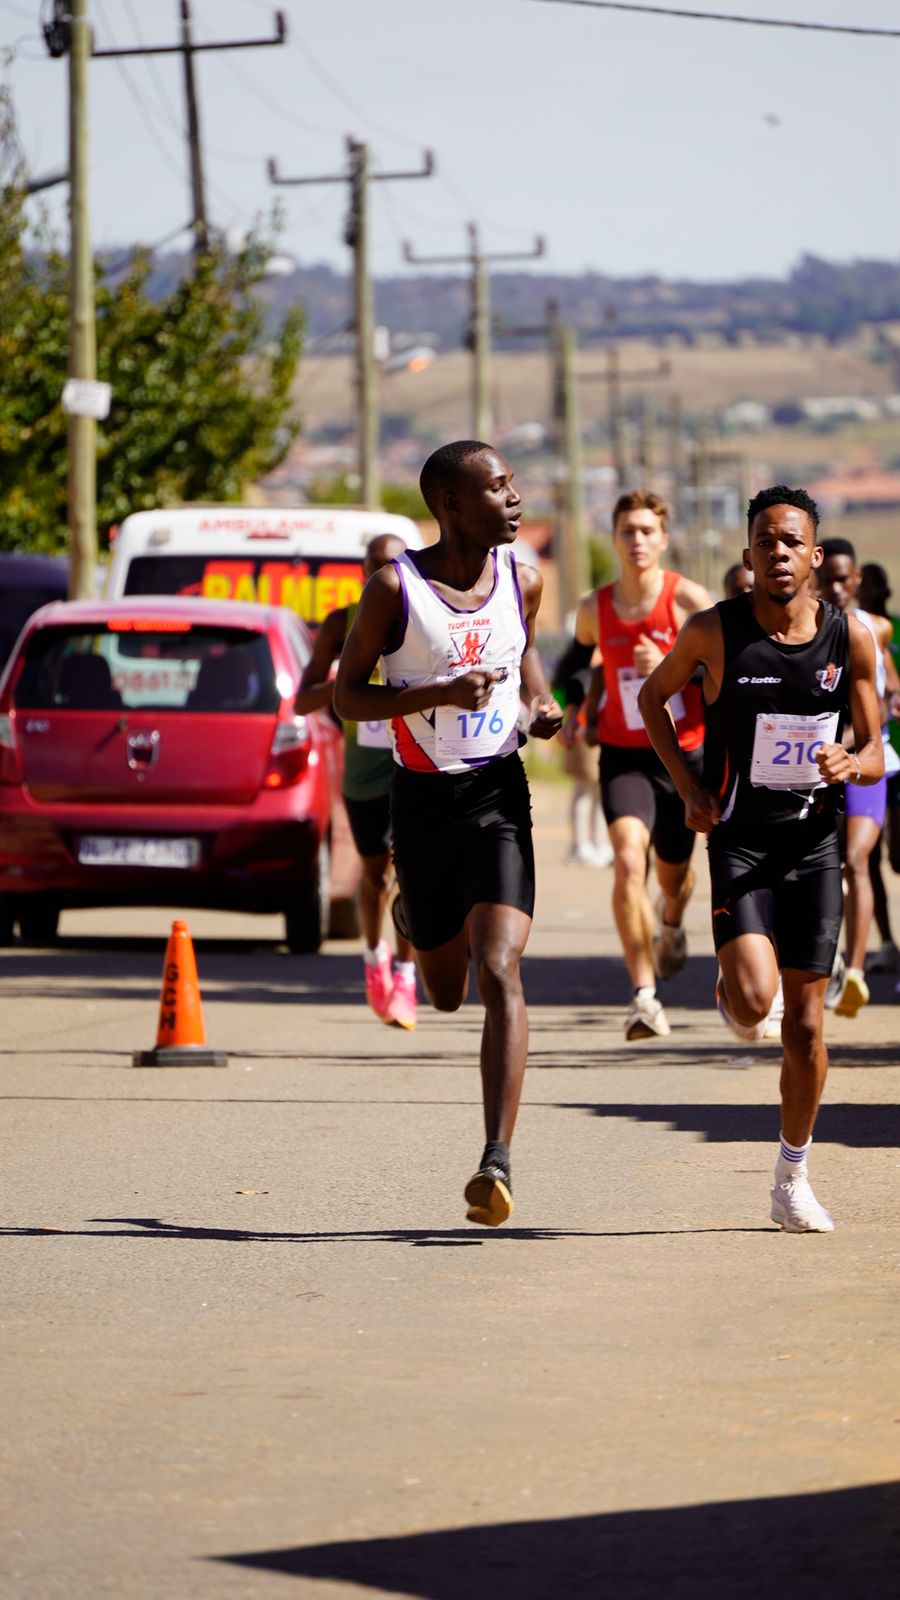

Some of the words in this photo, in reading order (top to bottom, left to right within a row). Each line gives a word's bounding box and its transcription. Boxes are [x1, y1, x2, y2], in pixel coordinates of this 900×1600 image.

[198, 517, 336, 534] AMBULANCE
[473, 618, 491, 627] PARK
[457, 709, 503, 738] 176
[772, 740, 824, 765] 210
